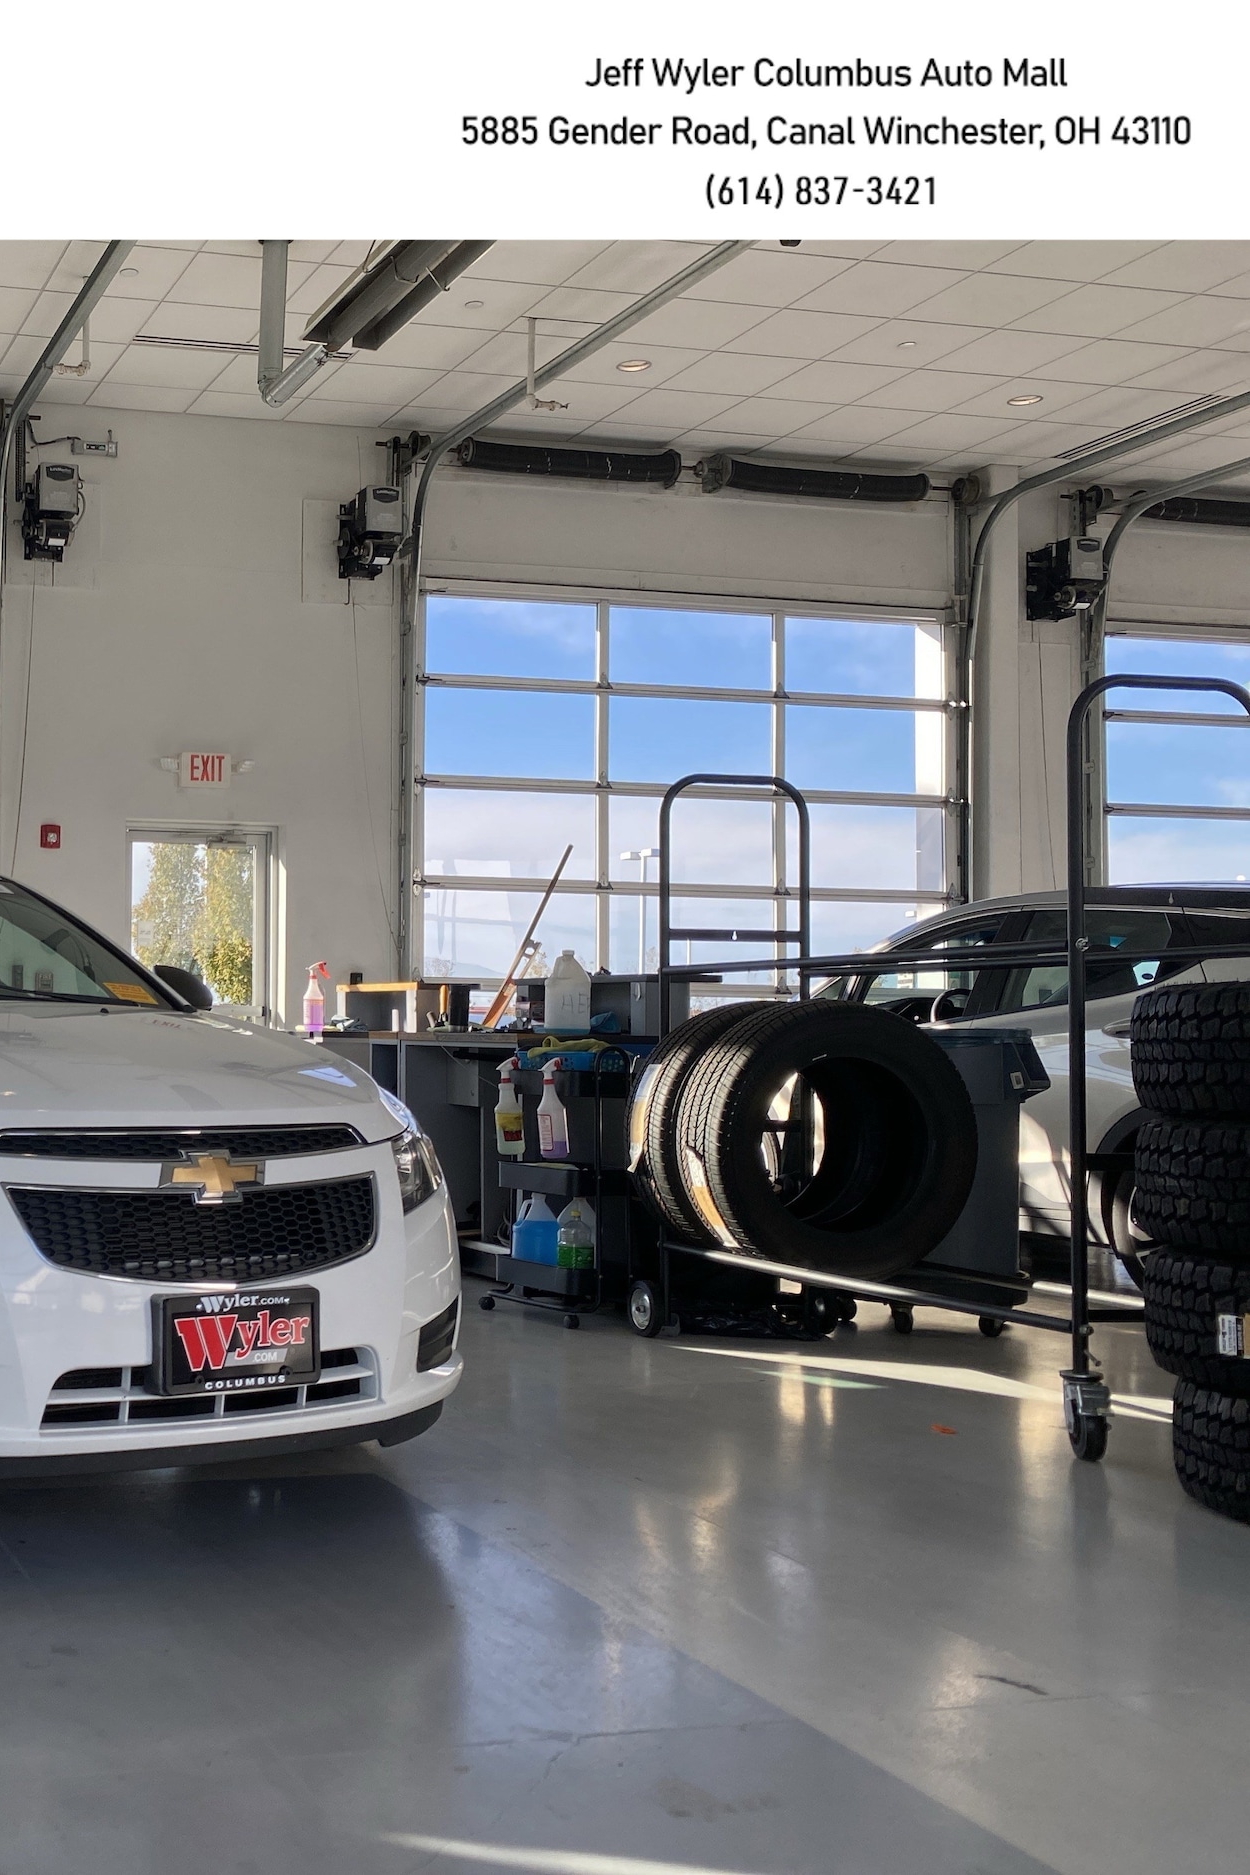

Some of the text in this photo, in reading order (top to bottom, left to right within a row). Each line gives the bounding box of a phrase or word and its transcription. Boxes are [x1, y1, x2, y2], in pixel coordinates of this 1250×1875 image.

[190, 754, 225, 782] EXIT
[174, 1310, 310, 1372] Wyler
[205, 1375, 286, 1391] COLUMBUS
